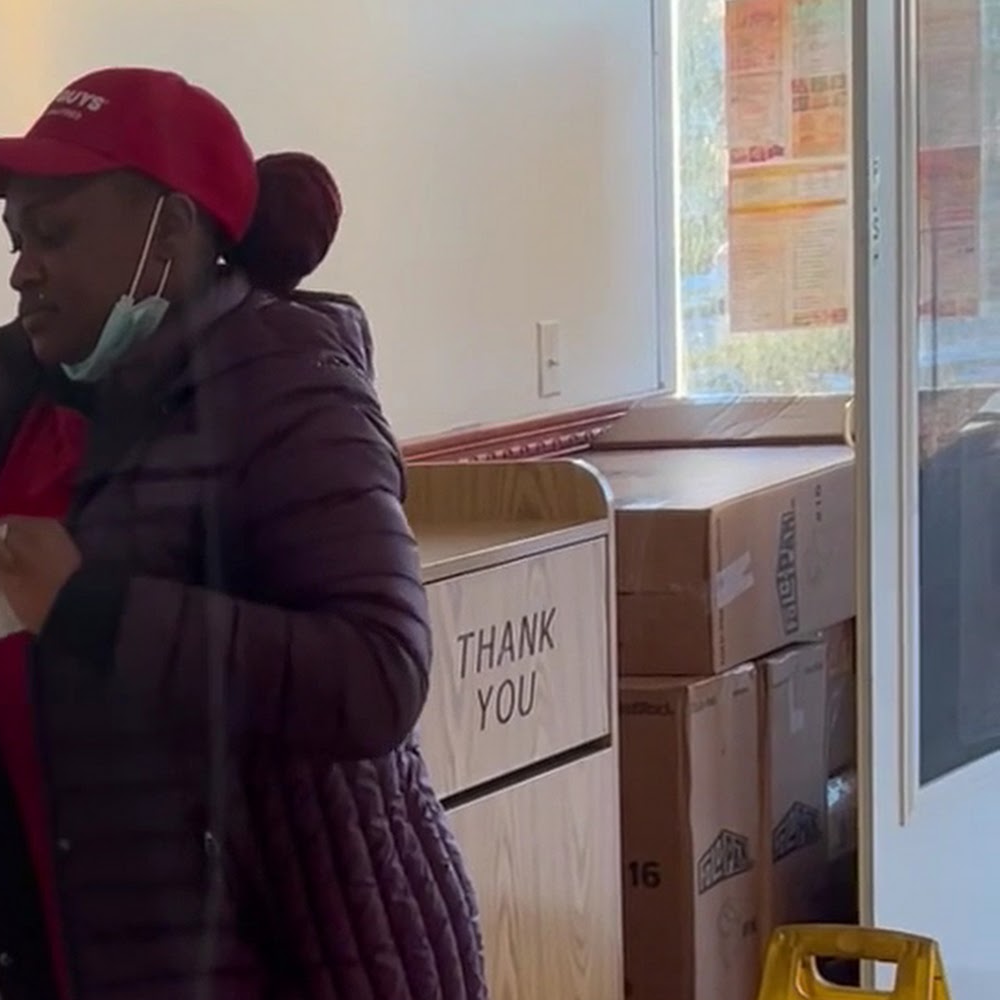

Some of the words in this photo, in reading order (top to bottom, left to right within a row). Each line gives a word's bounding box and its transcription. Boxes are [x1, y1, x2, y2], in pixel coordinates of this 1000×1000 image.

[457, 607, 556, 679] THANK
[477, 670, 536, 731] YOU
[629, 861, 662, 888] 16
